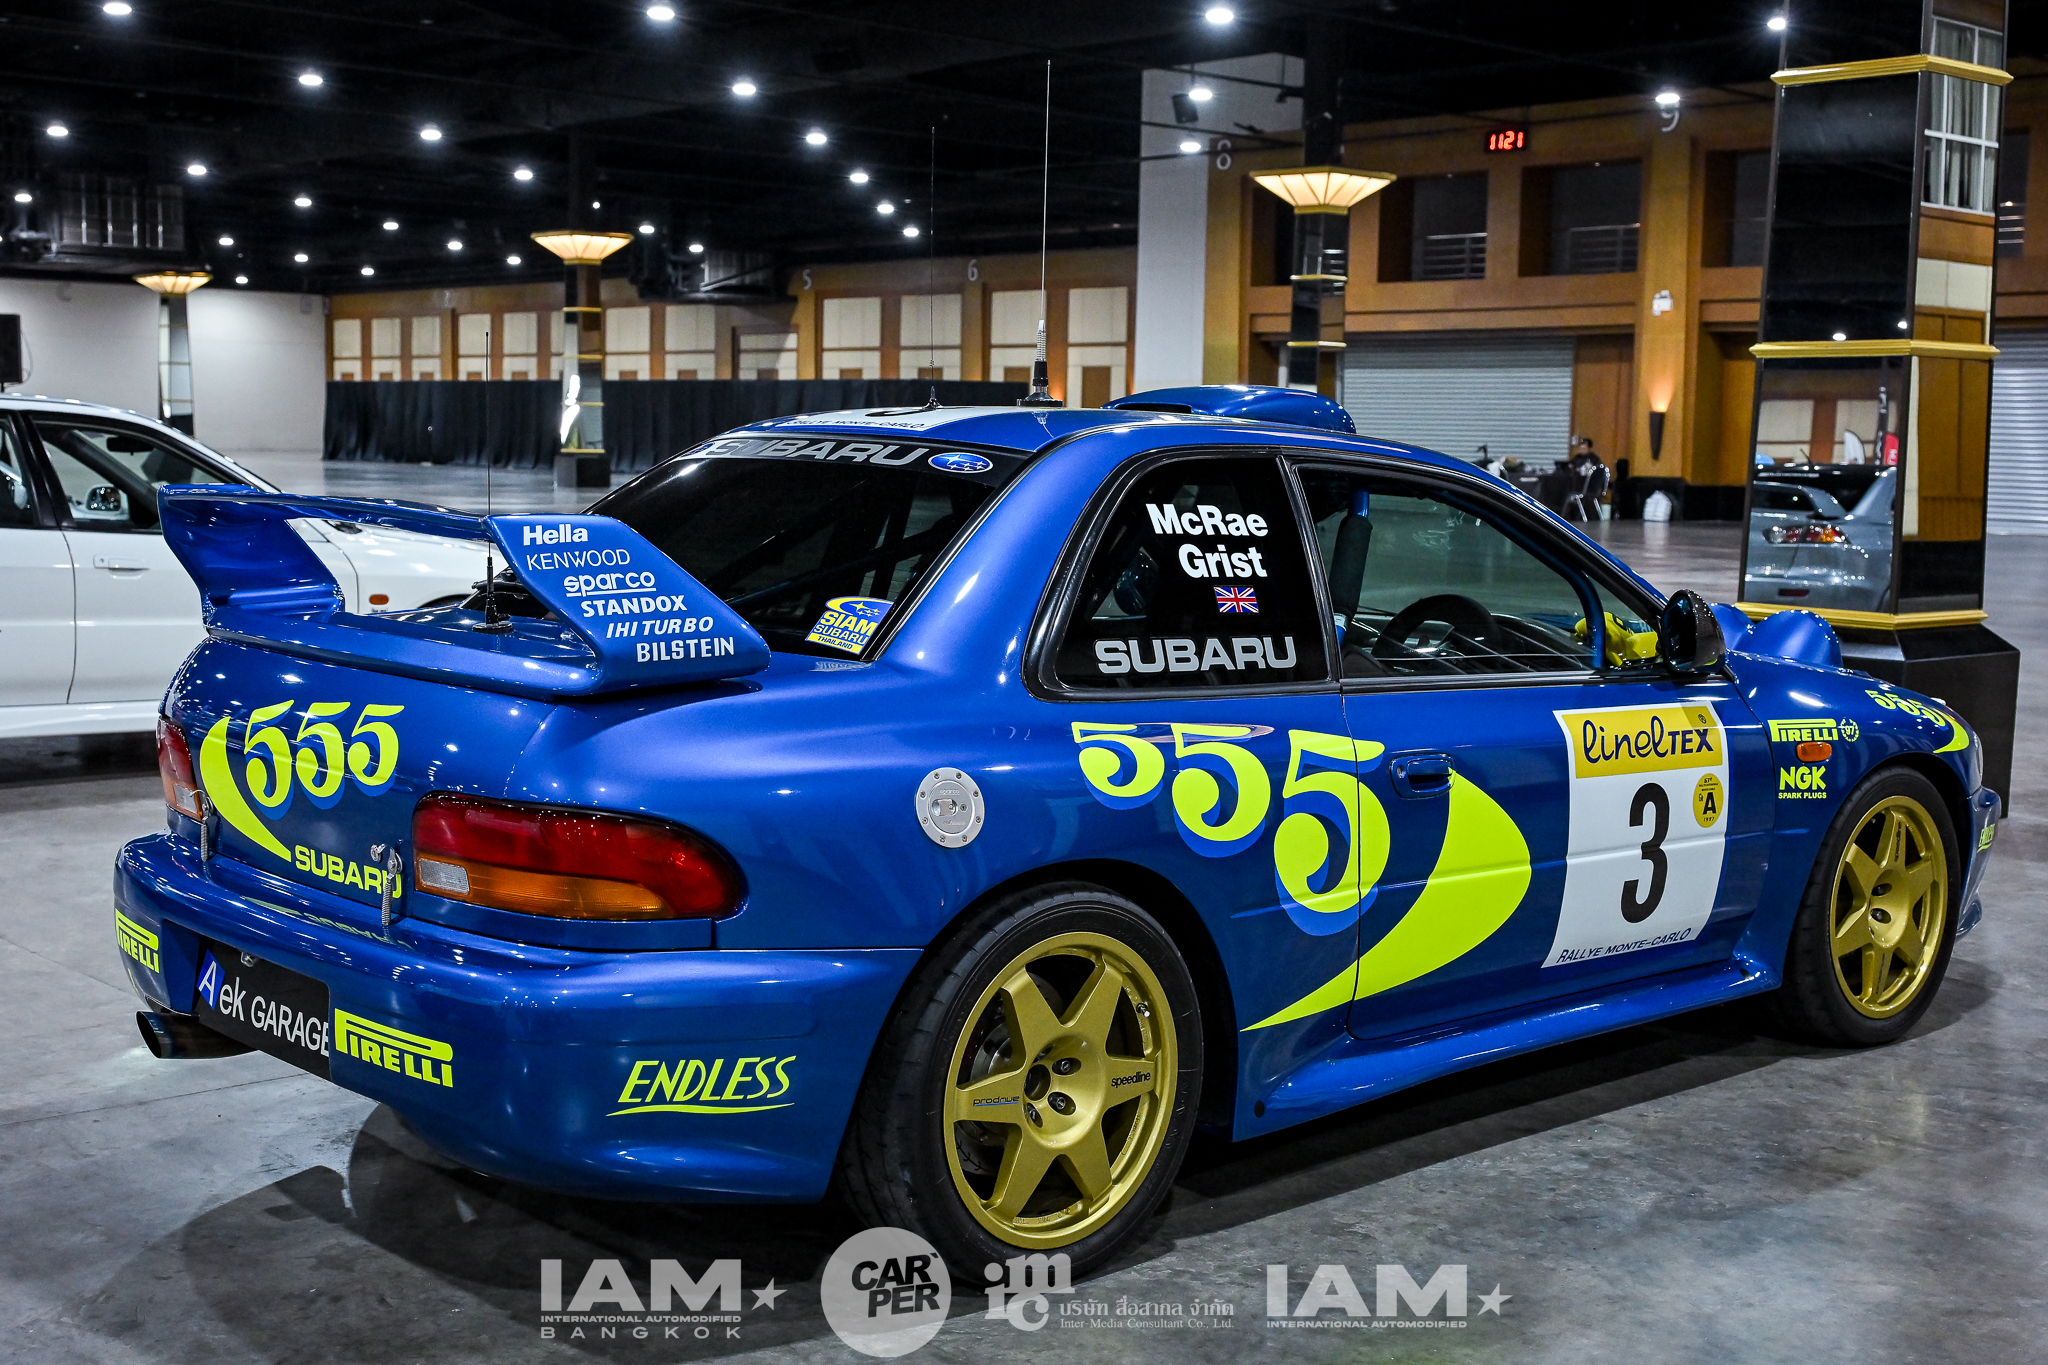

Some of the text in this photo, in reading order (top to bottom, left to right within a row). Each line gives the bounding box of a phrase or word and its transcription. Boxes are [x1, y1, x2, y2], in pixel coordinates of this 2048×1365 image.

[967, 258, 978, 282] 6
[707, 438, 929, 466] SUBARU
[1146, 503, 1269, 537] McRae
[523, 523, 588, 546] Hella
[527, 549, 631, 571] KENWOOD
[1178, 543, 1268, 579] Grist
[563, 571, 656, 598] sparco
[580, 594, 688, 618] STANDOX
[606, 616, 714, 639] IHI TURBO
[813, 624, 869, 645] SUBARU
[820, 611, 879, 637] SIAM
[636, 636, 735, 663] BILSTEIN
[817, 635, 853, 650] THAILAND
[1095, 636, 1297, 674] SUBARU
[1767, 718, 1839, 742] PIRELLI
[244, 700, 405, 808] 555
[1779, 765, 1827, 791] NGK
[1702, 791, 1717, 815] A
[1071, 721, 1391, 914] 555
[1620, 782, 1670, 924] 3
[115, 908, 160, 974] PIRELLI
[1556, 927, 1692, 963] RALLYE MONTE-CARLO
[335, 1008, 454, 1088] PIRELLI
[618, 1055, 797, 1103] ENDLESS
[1111, 1070, 1152, 1089] speedline
